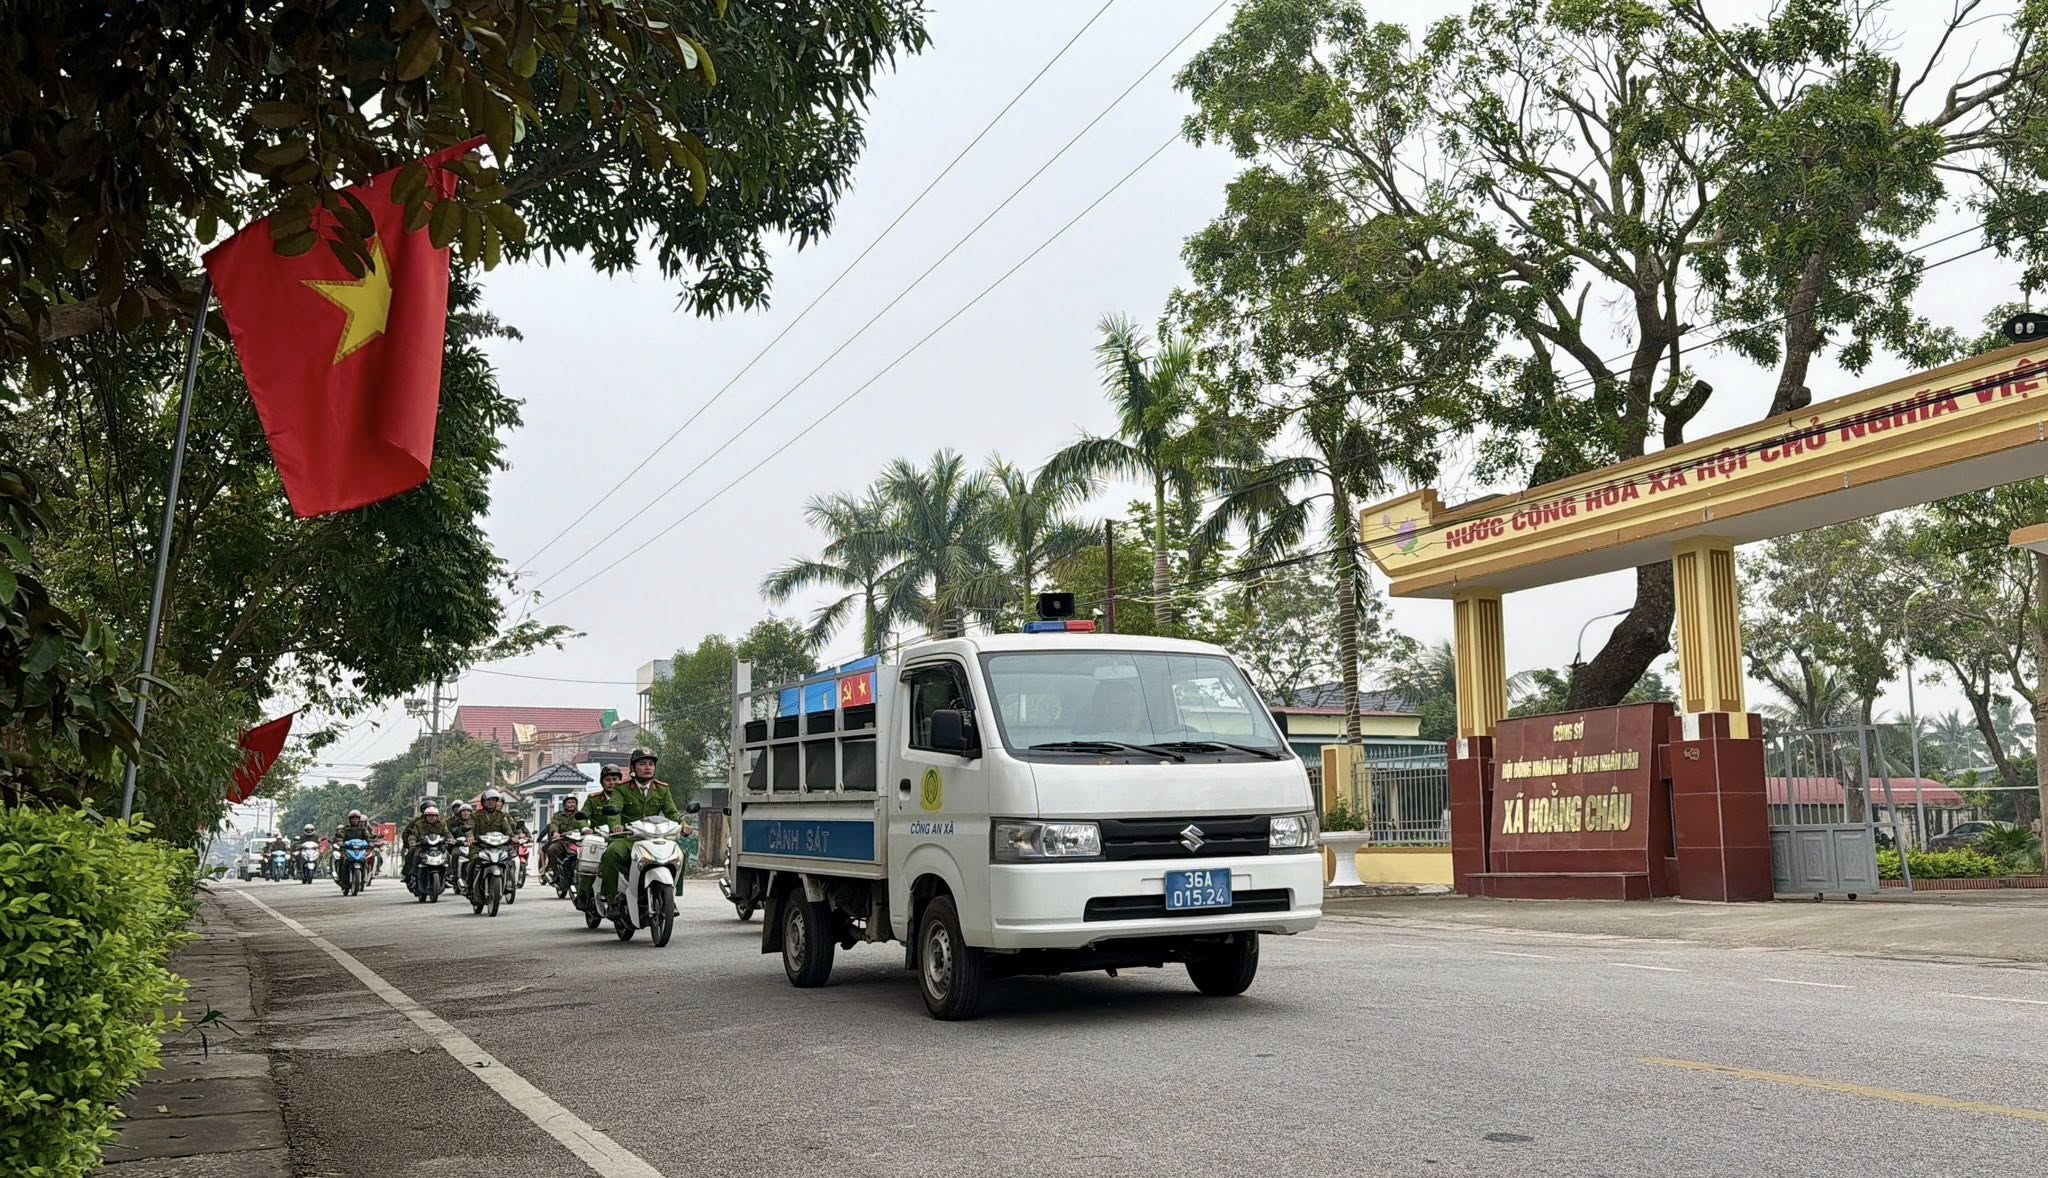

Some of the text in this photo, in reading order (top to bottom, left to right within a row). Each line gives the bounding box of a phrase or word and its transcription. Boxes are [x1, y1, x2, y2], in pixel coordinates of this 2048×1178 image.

[1512, 496, 1577, 531] CỘNG
[1696, 446, 1749, 480] HỘI
[1760, 416, 1827, 463] CHỦ
[1839, 388, 1959, 443] NGHĨA
[1970, 358, 2048, 405] VIỆ
[1502, 782, 1632, 834] XÃ HOẰNG CHÂU
[806, 824, 830, 853] SÁT
[910, 820, 954, 835] CÔNG AN XÃ
[1184, 871, 1213, 888] 36A
[1173, 888, 1225, 907] 015.24
